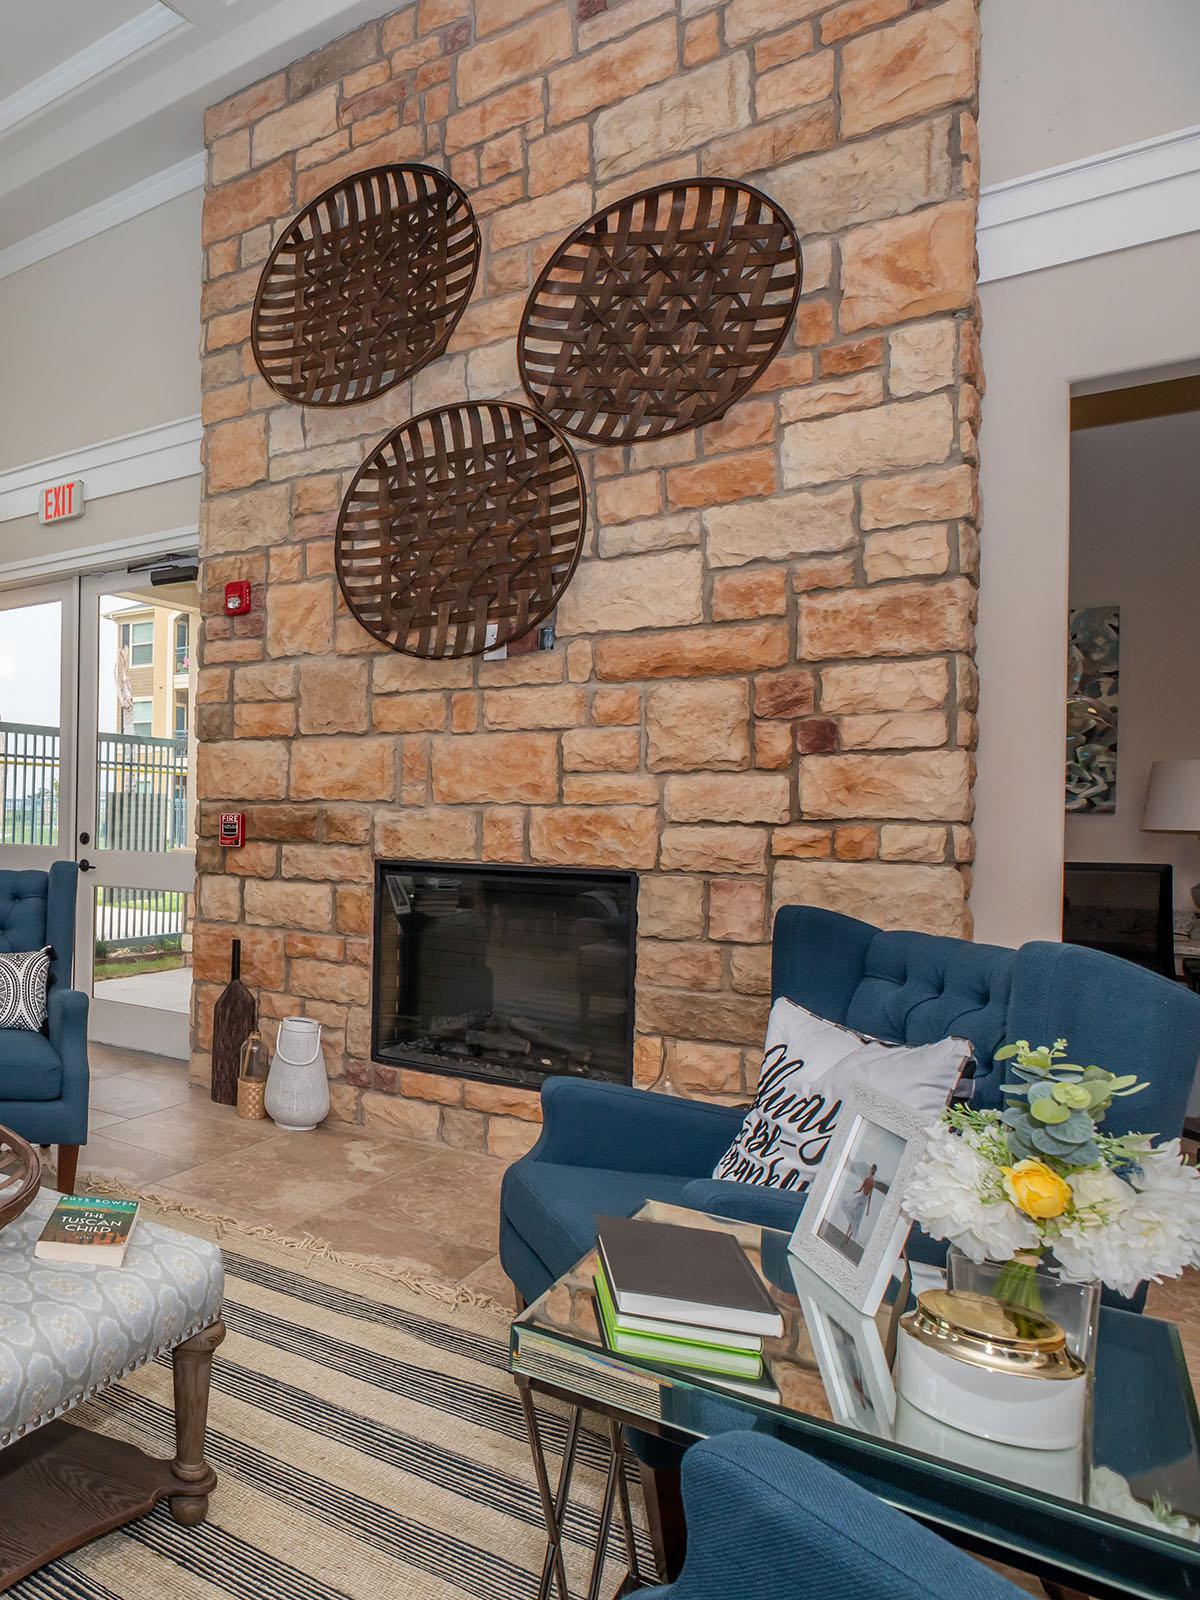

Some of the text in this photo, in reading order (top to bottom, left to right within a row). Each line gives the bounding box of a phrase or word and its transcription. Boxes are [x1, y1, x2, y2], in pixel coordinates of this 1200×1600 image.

[44, 482, 75, 521] EXIT
[96, 1198, 136, 1206] BOWEN
[62, 1216, 121, 1227] TUSCAN
[65, 1224, 111, 1232] CHILD
